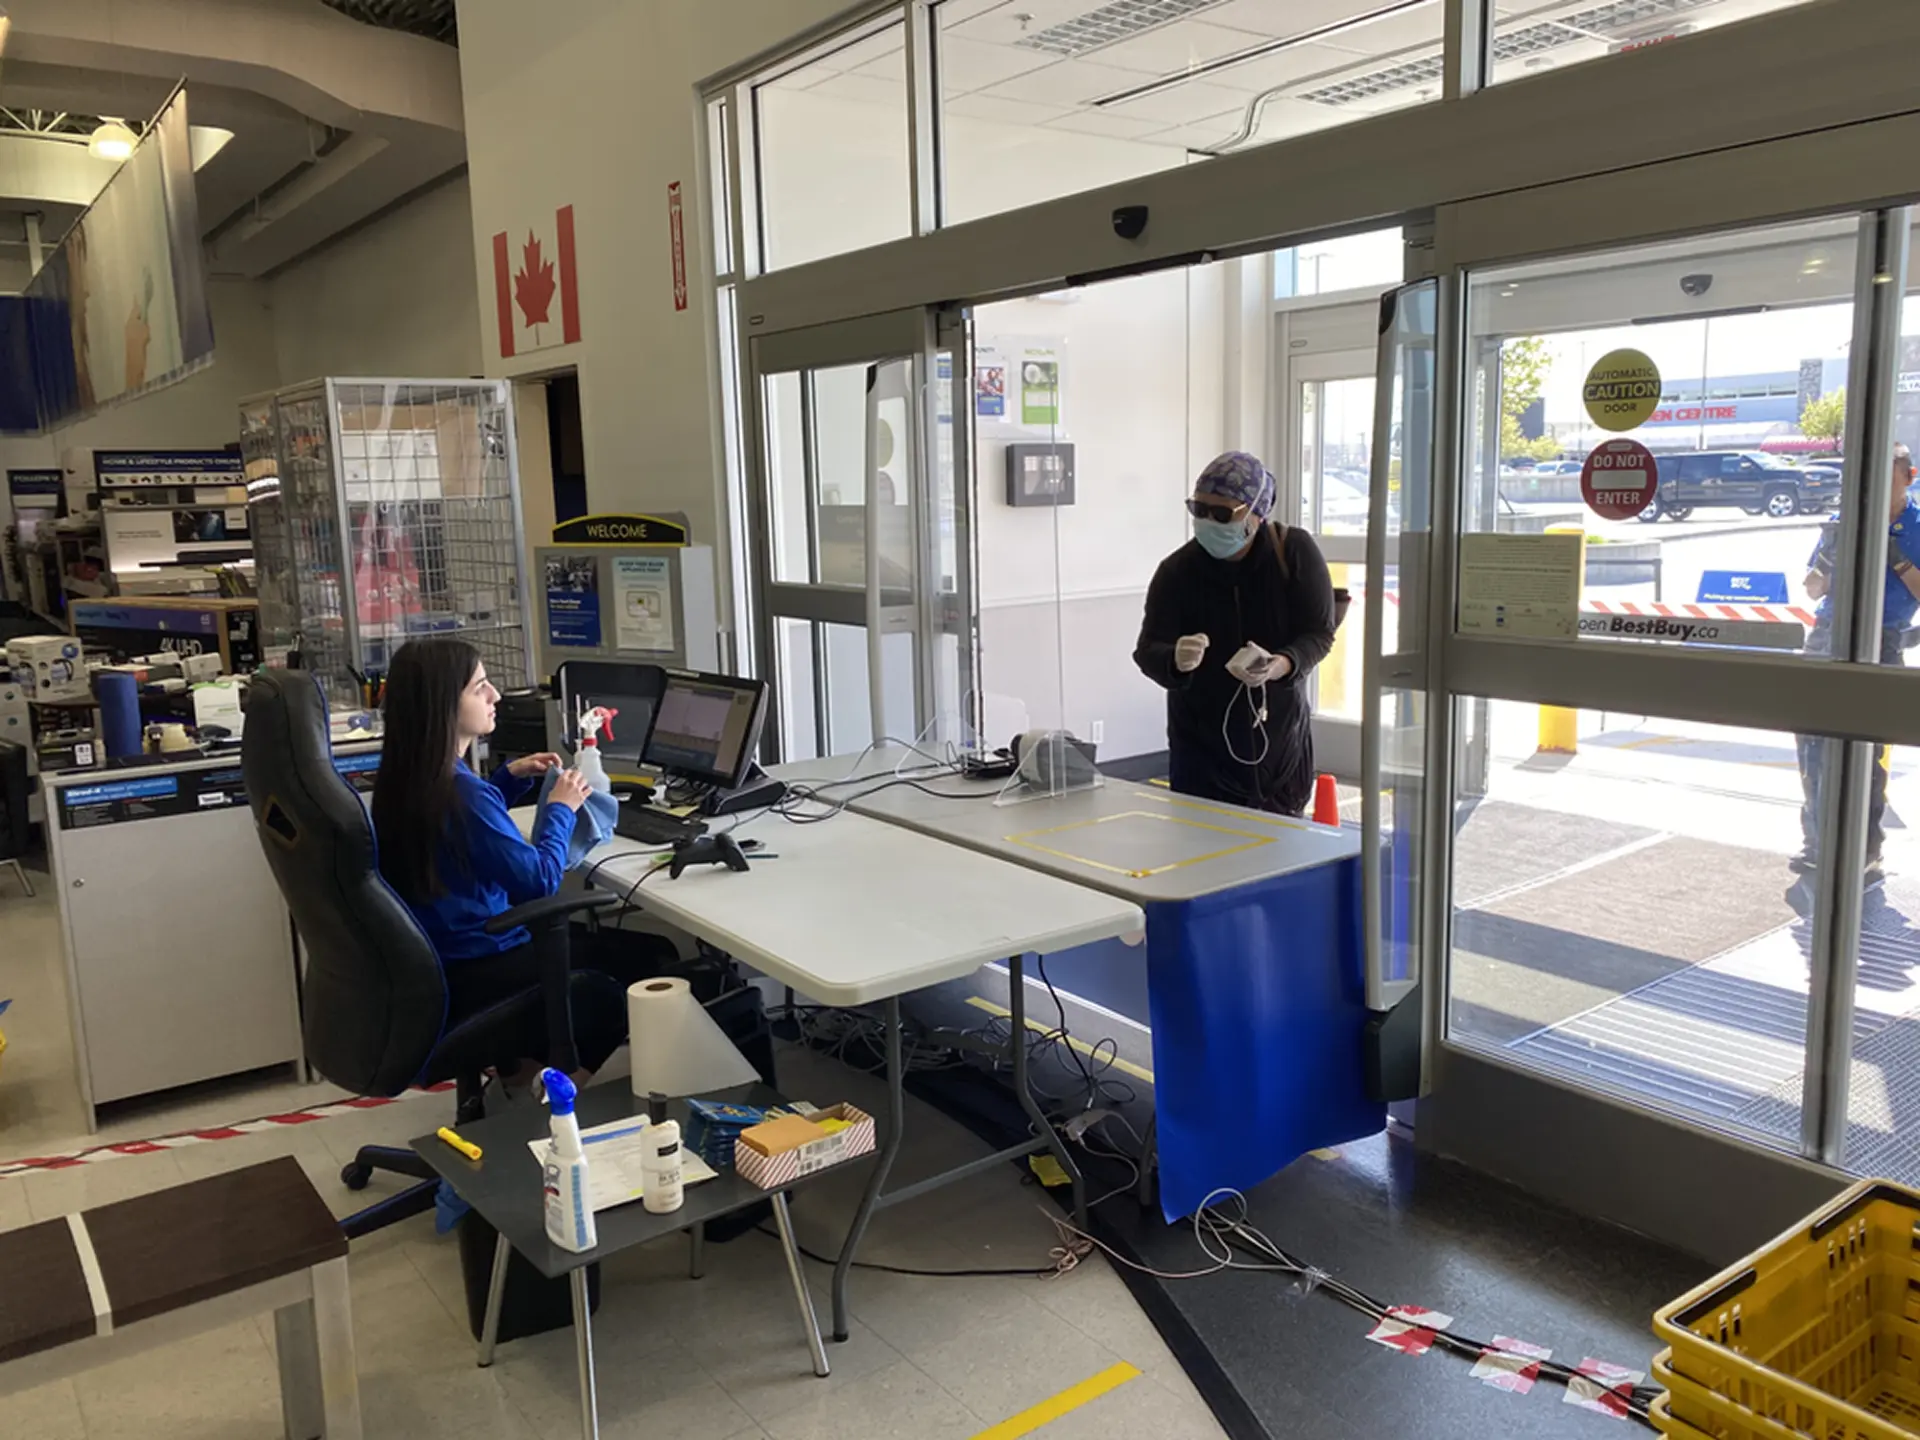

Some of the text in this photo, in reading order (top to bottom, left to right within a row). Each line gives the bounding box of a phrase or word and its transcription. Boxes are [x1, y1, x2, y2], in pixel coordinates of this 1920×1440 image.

[1590, 367, 1653, 380] AUTOMATIC
[1585, 382, 1660, 400] CAUTION
[1604, 403, 1637, 413] DOOR
[1650, 406, 1737, 421] EN CENTRE
[1593, 454, 1645, 468] DO NOT
[1596, 491, 1640, 505] ENTER
[586, 523, 648, 538] WELCOME
[1610, 616, 1719, 640] BestBuy.ca
